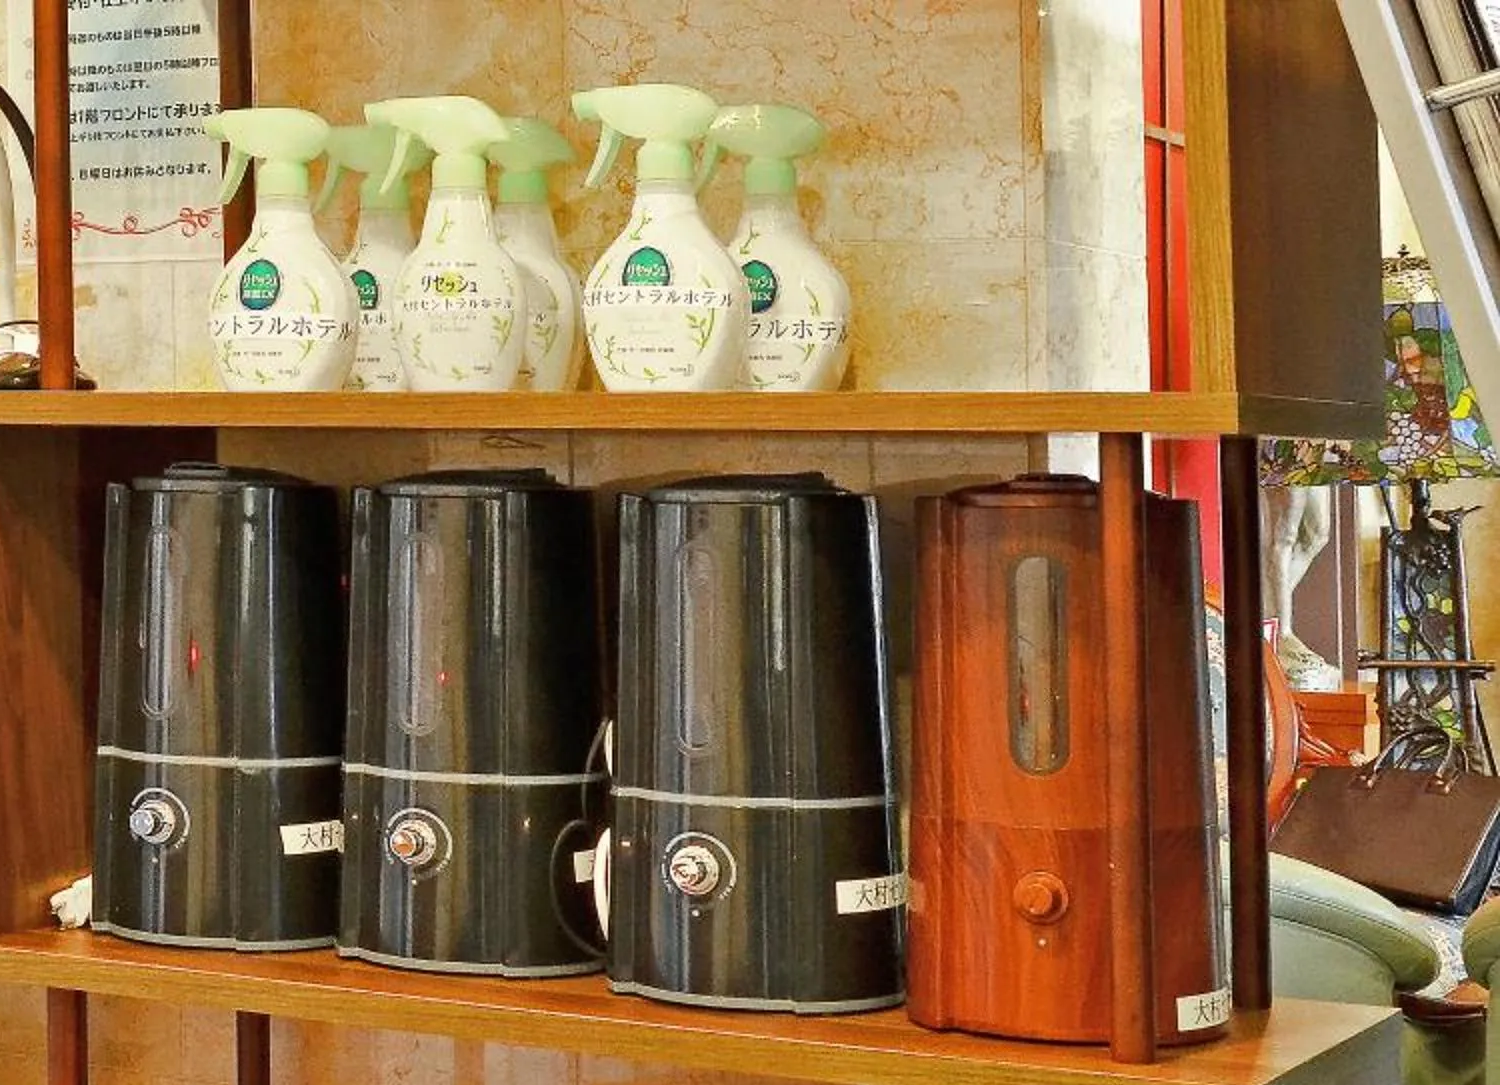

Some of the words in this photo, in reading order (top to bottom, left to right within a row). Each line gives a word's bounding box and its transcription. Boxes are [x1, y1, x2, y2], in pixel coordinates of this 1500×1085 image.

[420, 274, 479, 294] リセッシュ
